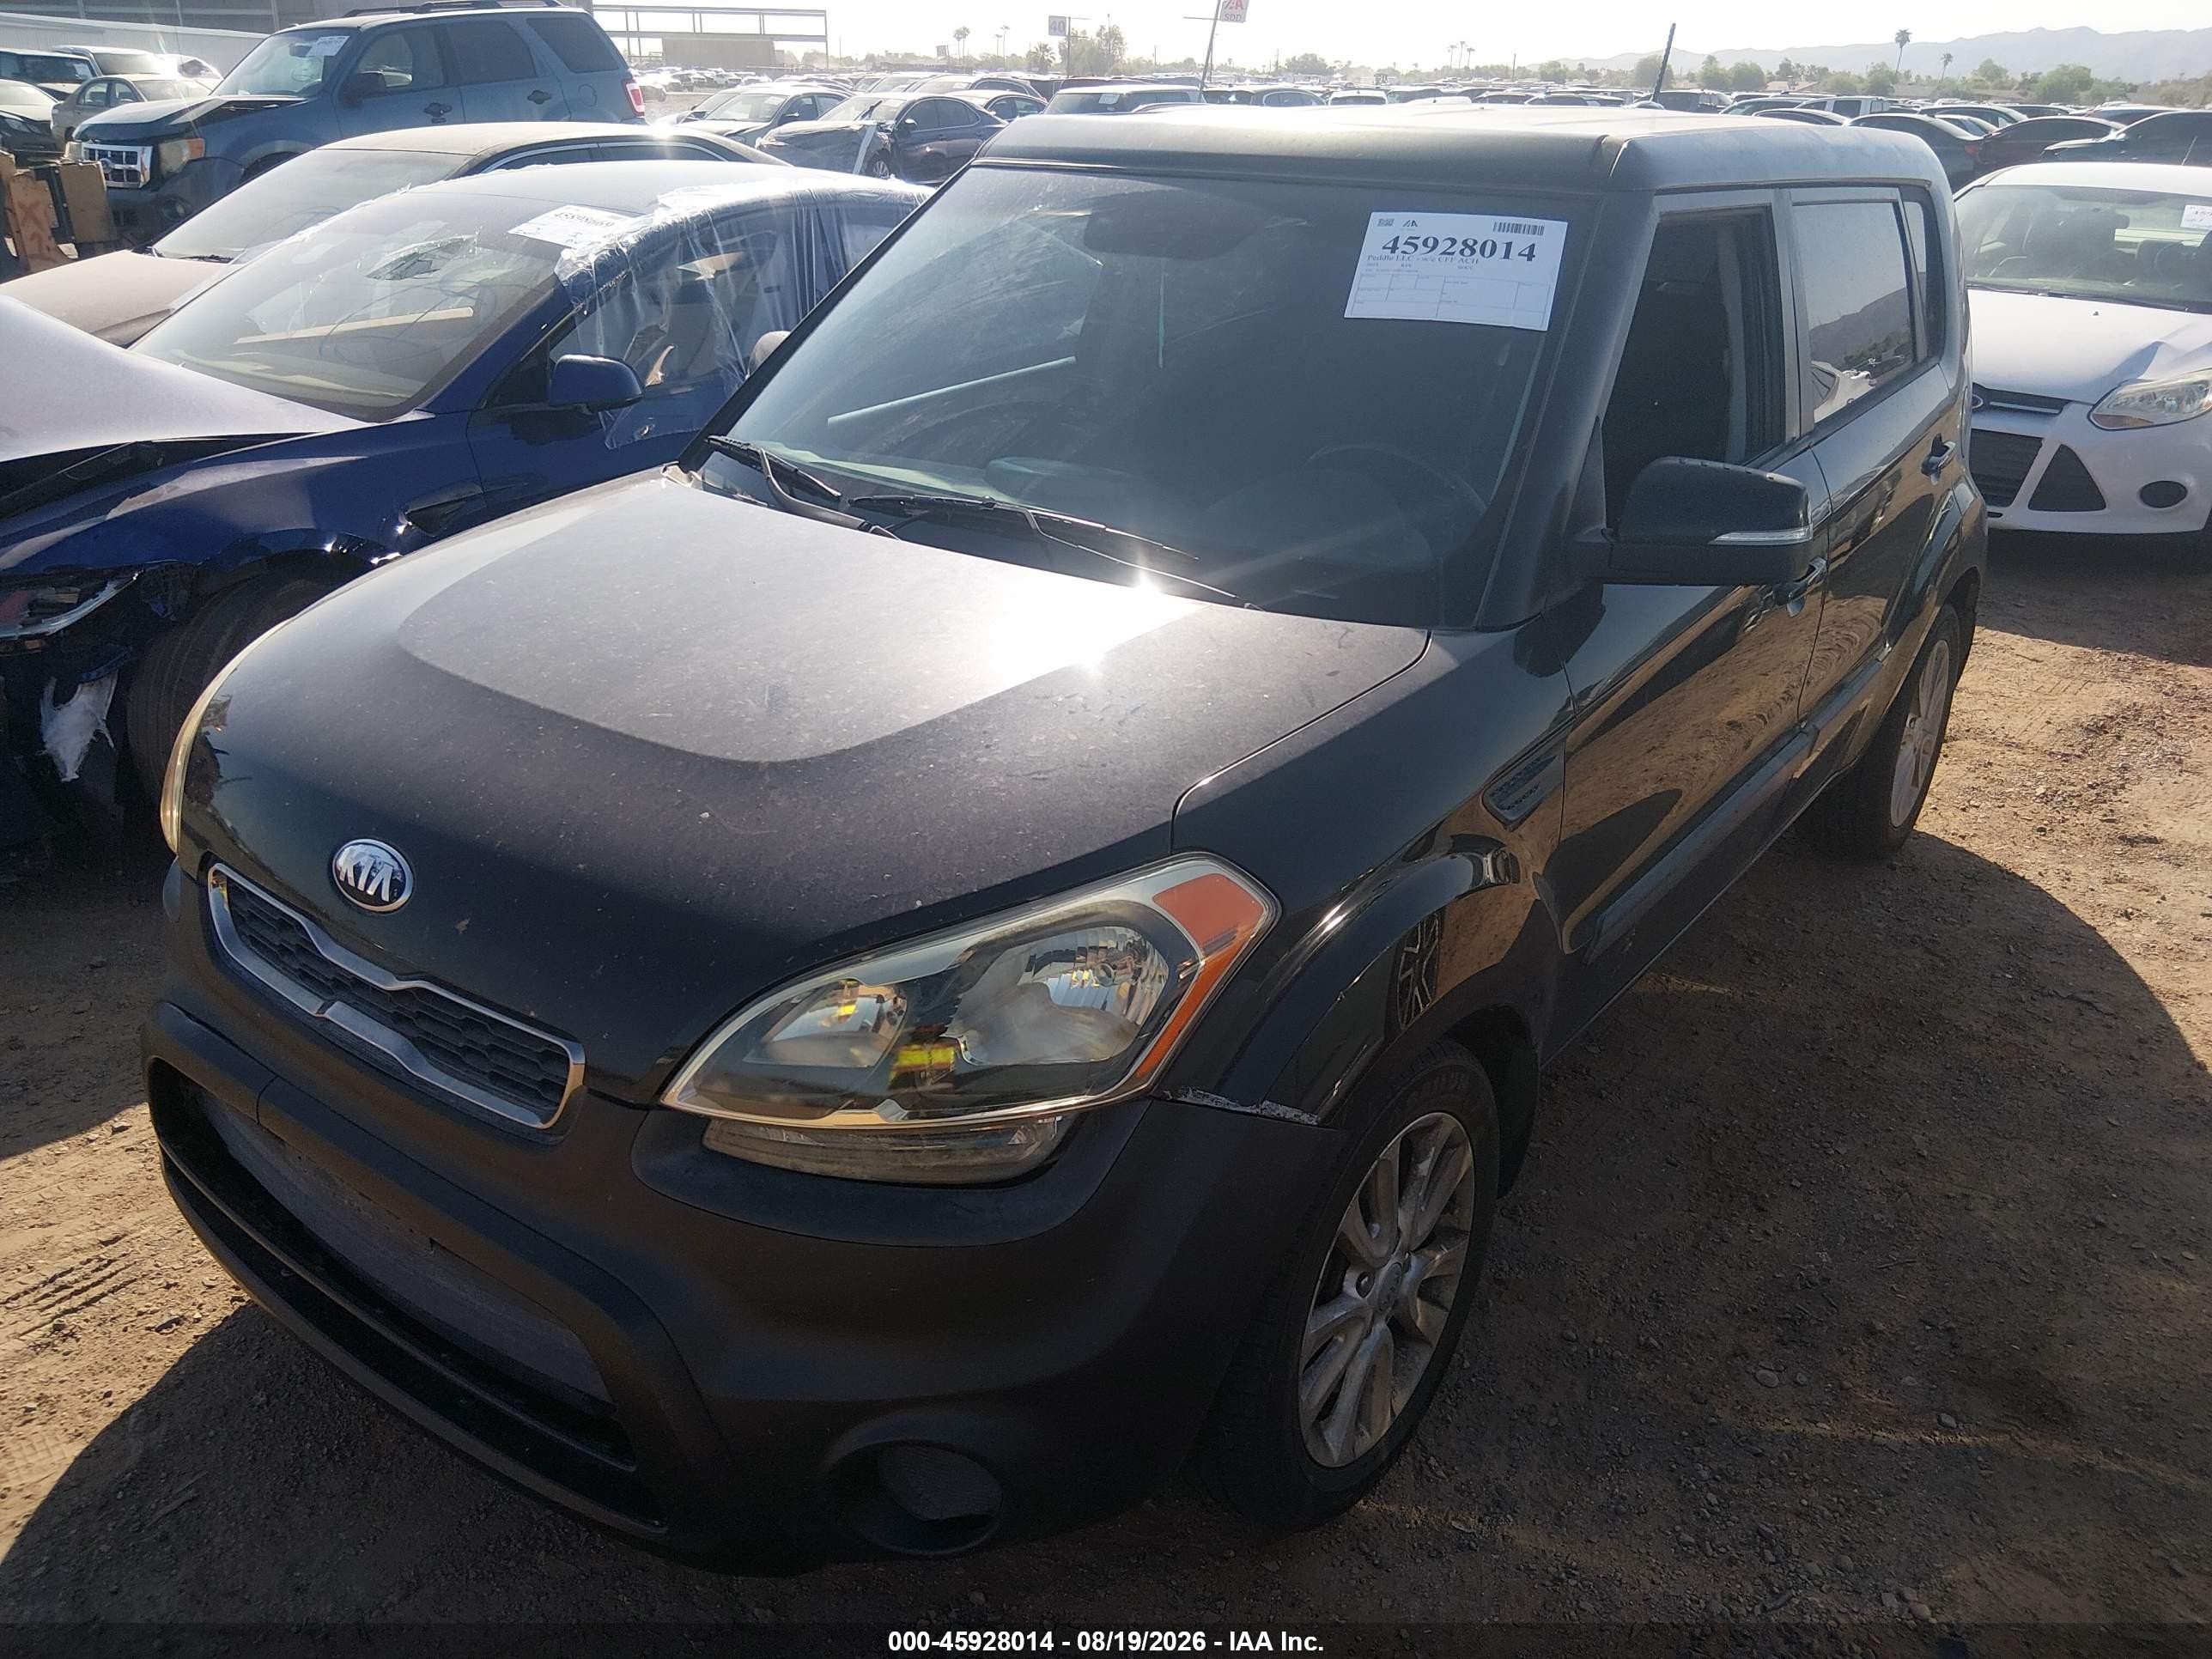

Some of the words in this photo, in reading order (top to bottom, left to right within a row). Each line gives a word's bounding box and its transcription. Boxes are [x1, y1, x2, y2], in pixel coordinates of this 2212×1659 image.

[1049, 20, 1066, 33] 40
[1382, 235, 1536, 262] 45928014
[336, 846, 395, 903] KIA
